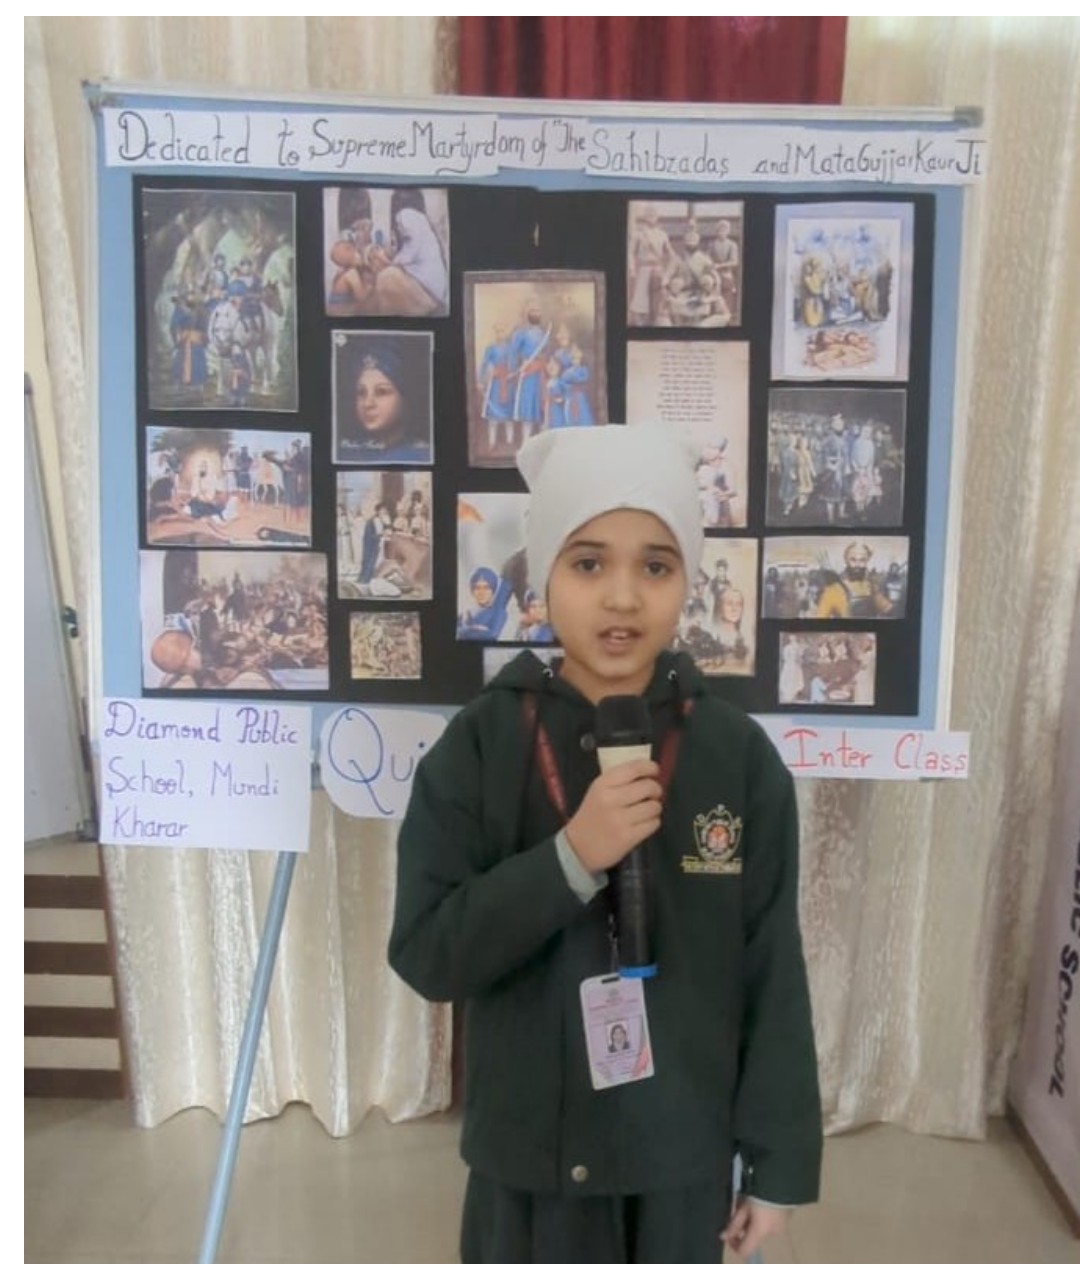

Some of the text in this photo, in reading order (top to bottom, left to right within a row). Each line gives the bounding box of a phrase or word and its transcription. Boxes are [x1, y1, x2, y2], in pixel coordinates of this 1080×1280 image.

[119, 111, 252, 164] Dedicated
[277, 118, 300, 167] to
[533, 119, 548, 168] of
[588, 128, 728, 178] Sahibzadas
[753, 141, 790, 175] and
[104, 701, 299, 746] Diamond Public
[784, 728, 968, 775] Inter Class
[106, 756, 279, 799] School, Mundi
[111, 806, 191, 840] Kharar
